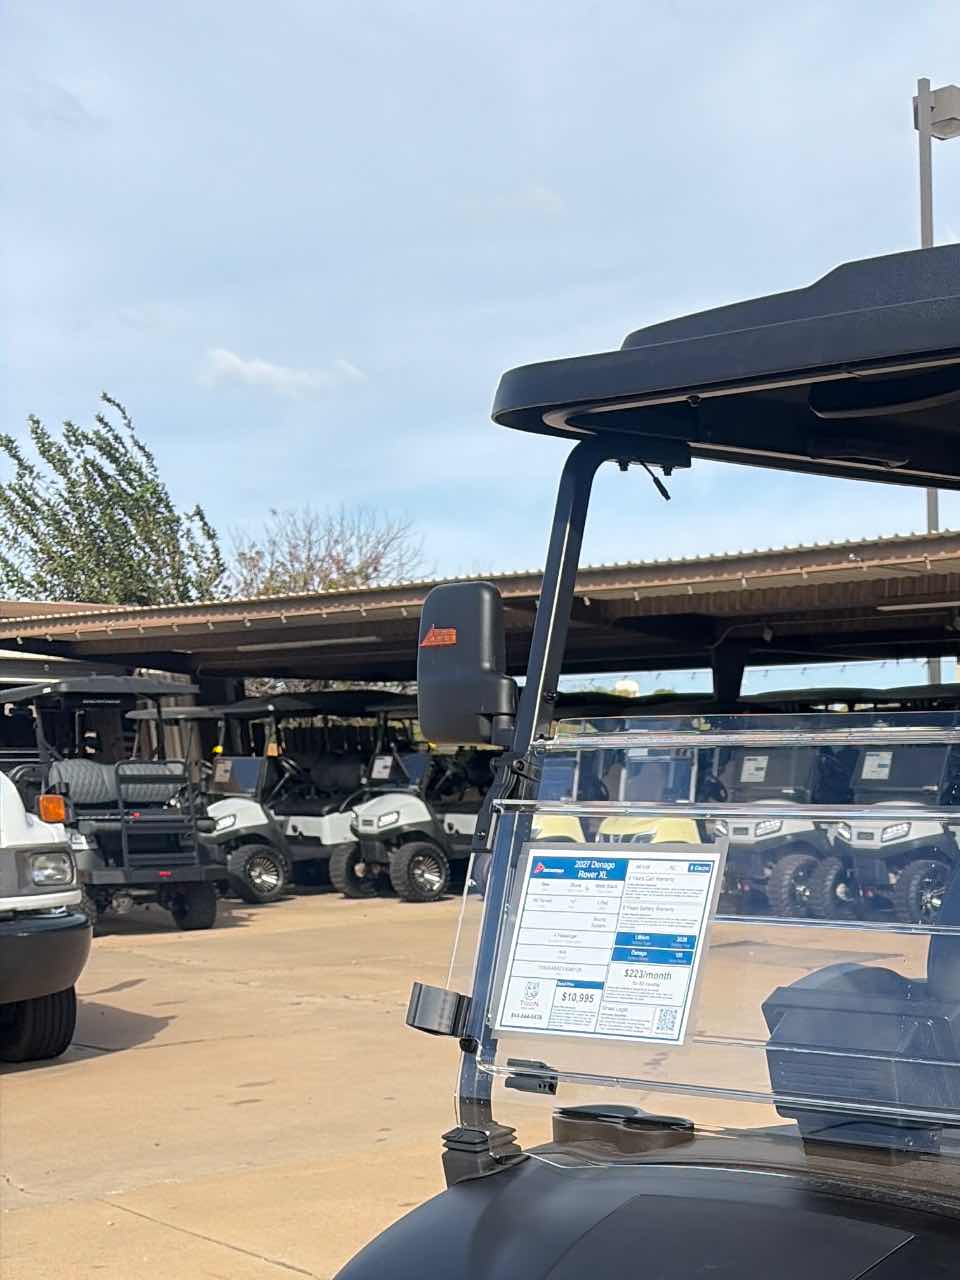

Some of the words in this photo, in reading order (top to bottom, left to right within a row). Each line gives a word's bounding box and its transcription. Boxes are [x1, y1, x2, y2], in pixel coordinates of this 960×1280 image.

[577, 870, 599, 878] Rover
[598, 870, 608, 879] XL
[623, 967, 672, 980] $223/month
[561, 991, 595, 1003] $10,995
